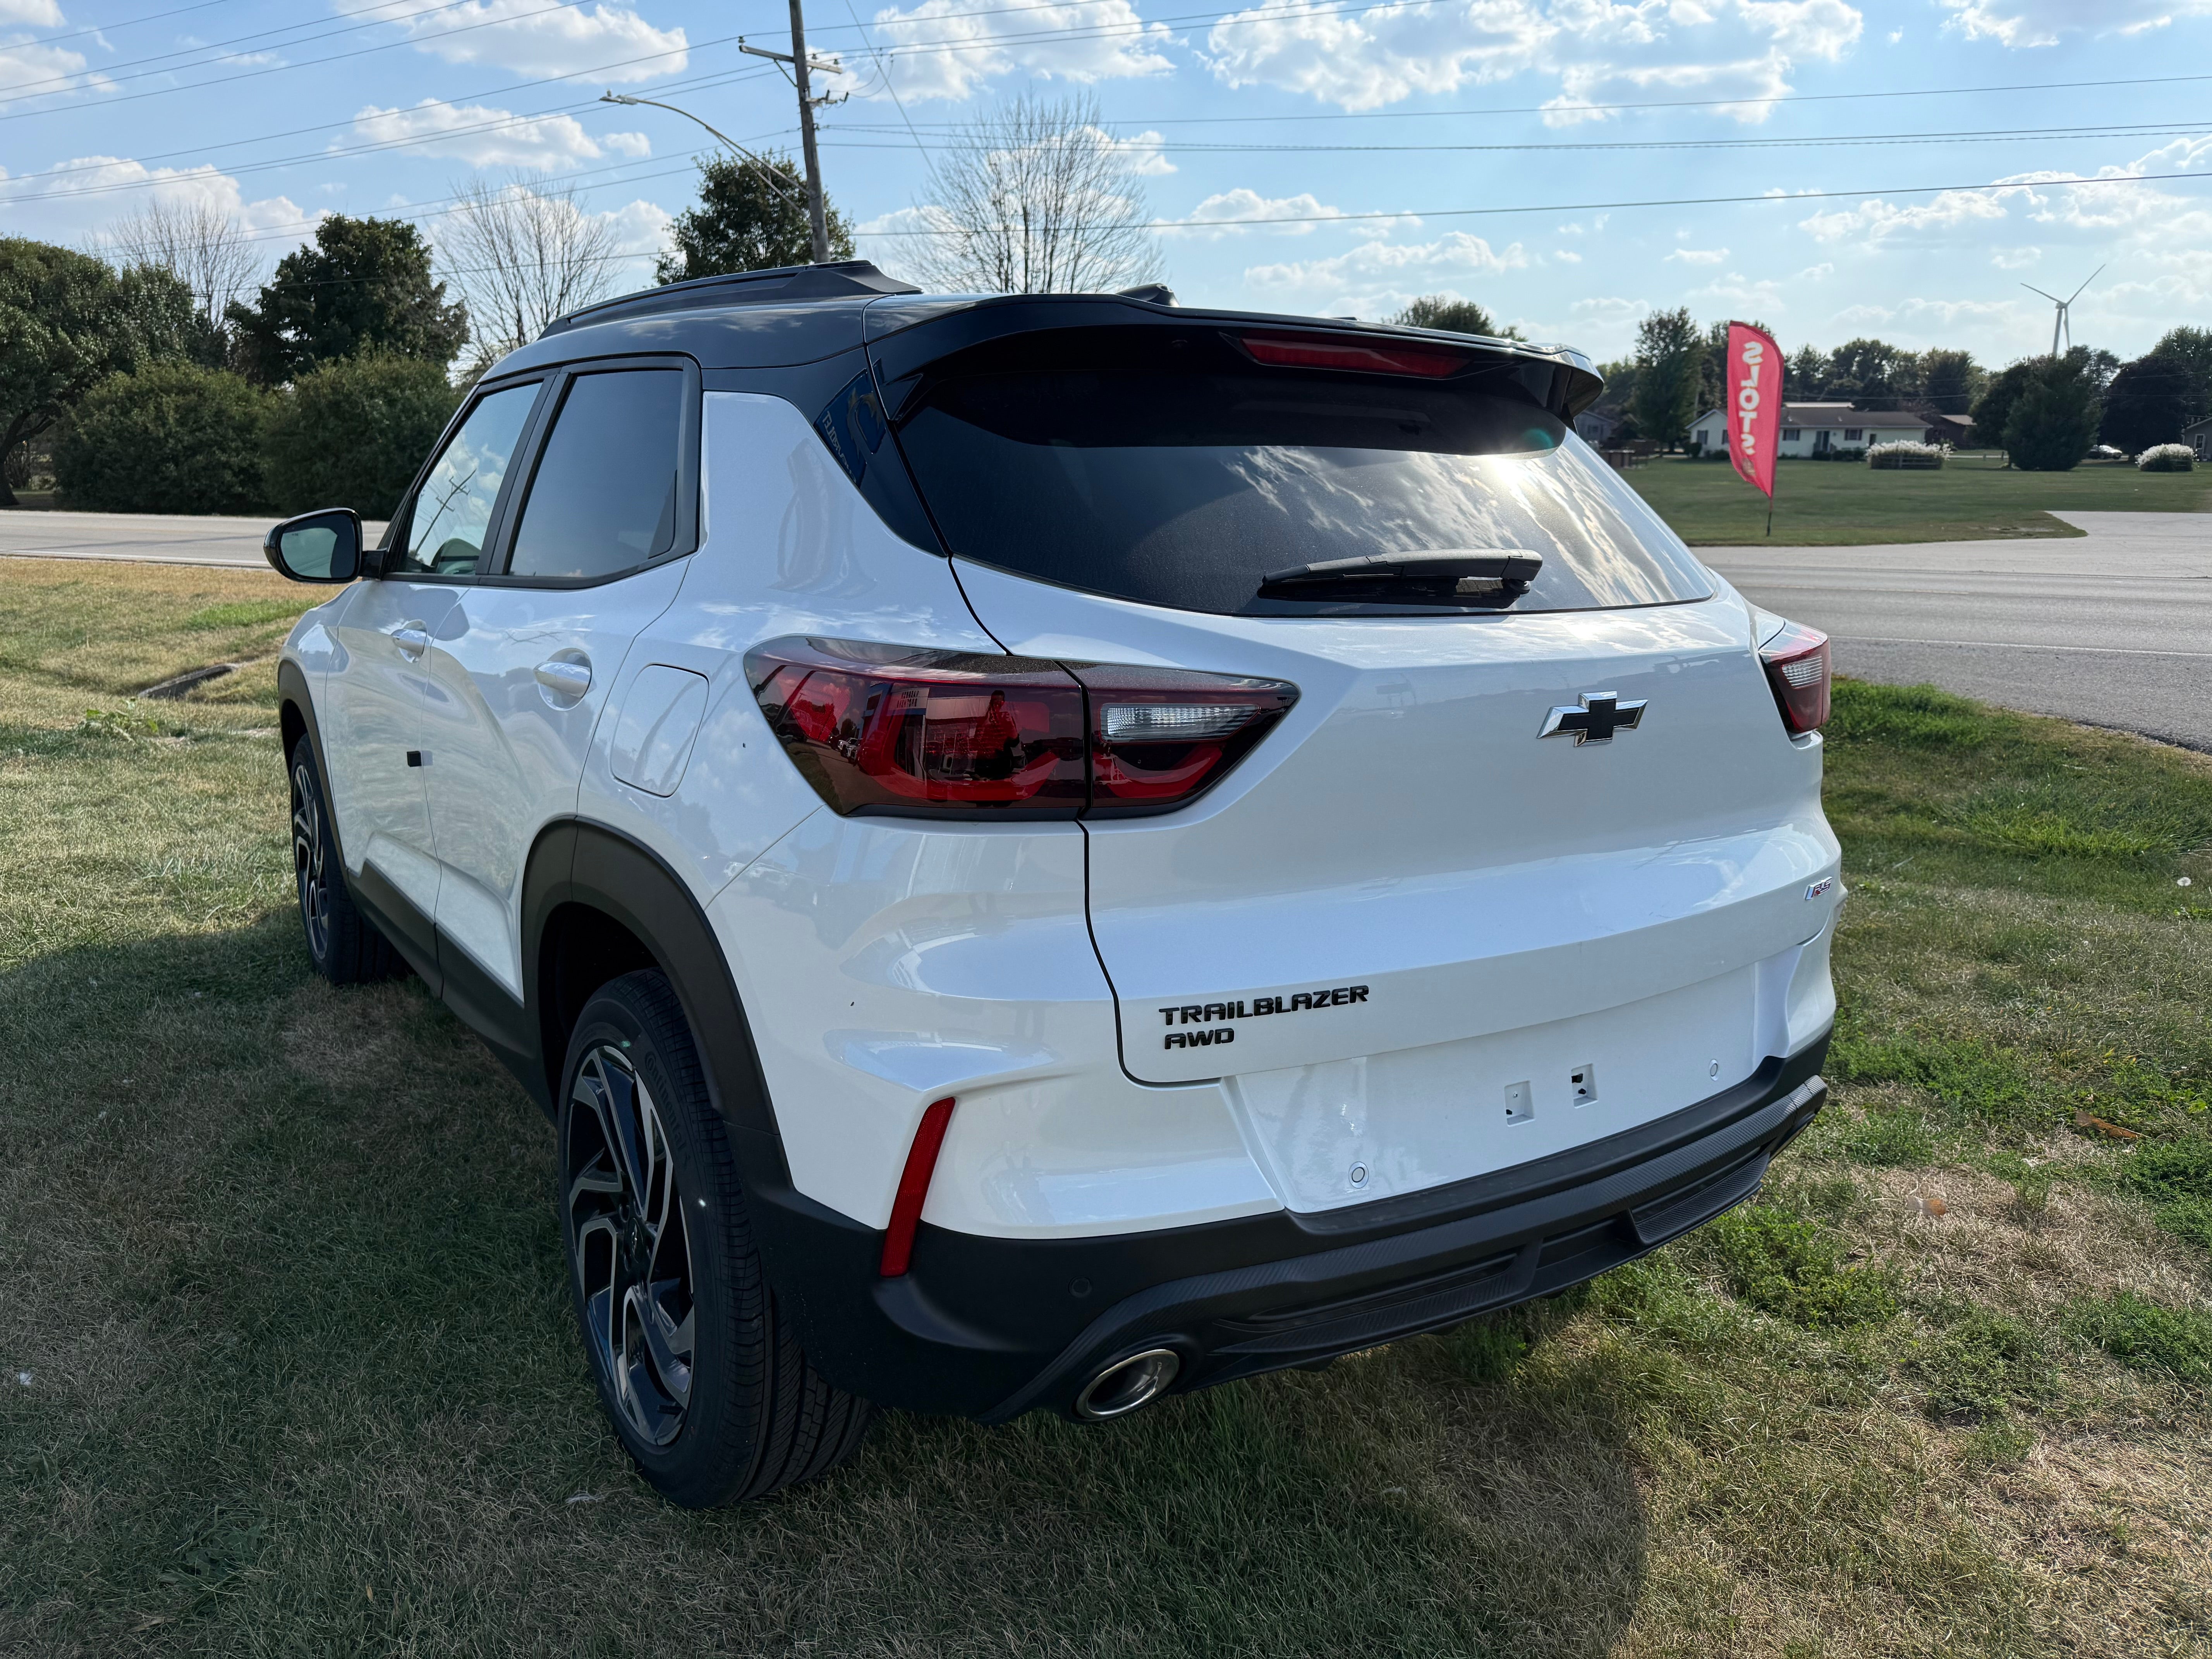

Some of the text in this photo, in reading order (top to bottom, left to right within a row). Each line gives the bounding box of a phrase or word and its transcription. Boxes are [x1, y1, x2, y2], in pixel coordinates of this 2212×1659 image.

[1805, 876, 1832, 900] RS
[1159, 985, 1369, 1025] TRAILBLAZER
[1164, 1027, 1235, 1049] AWD
